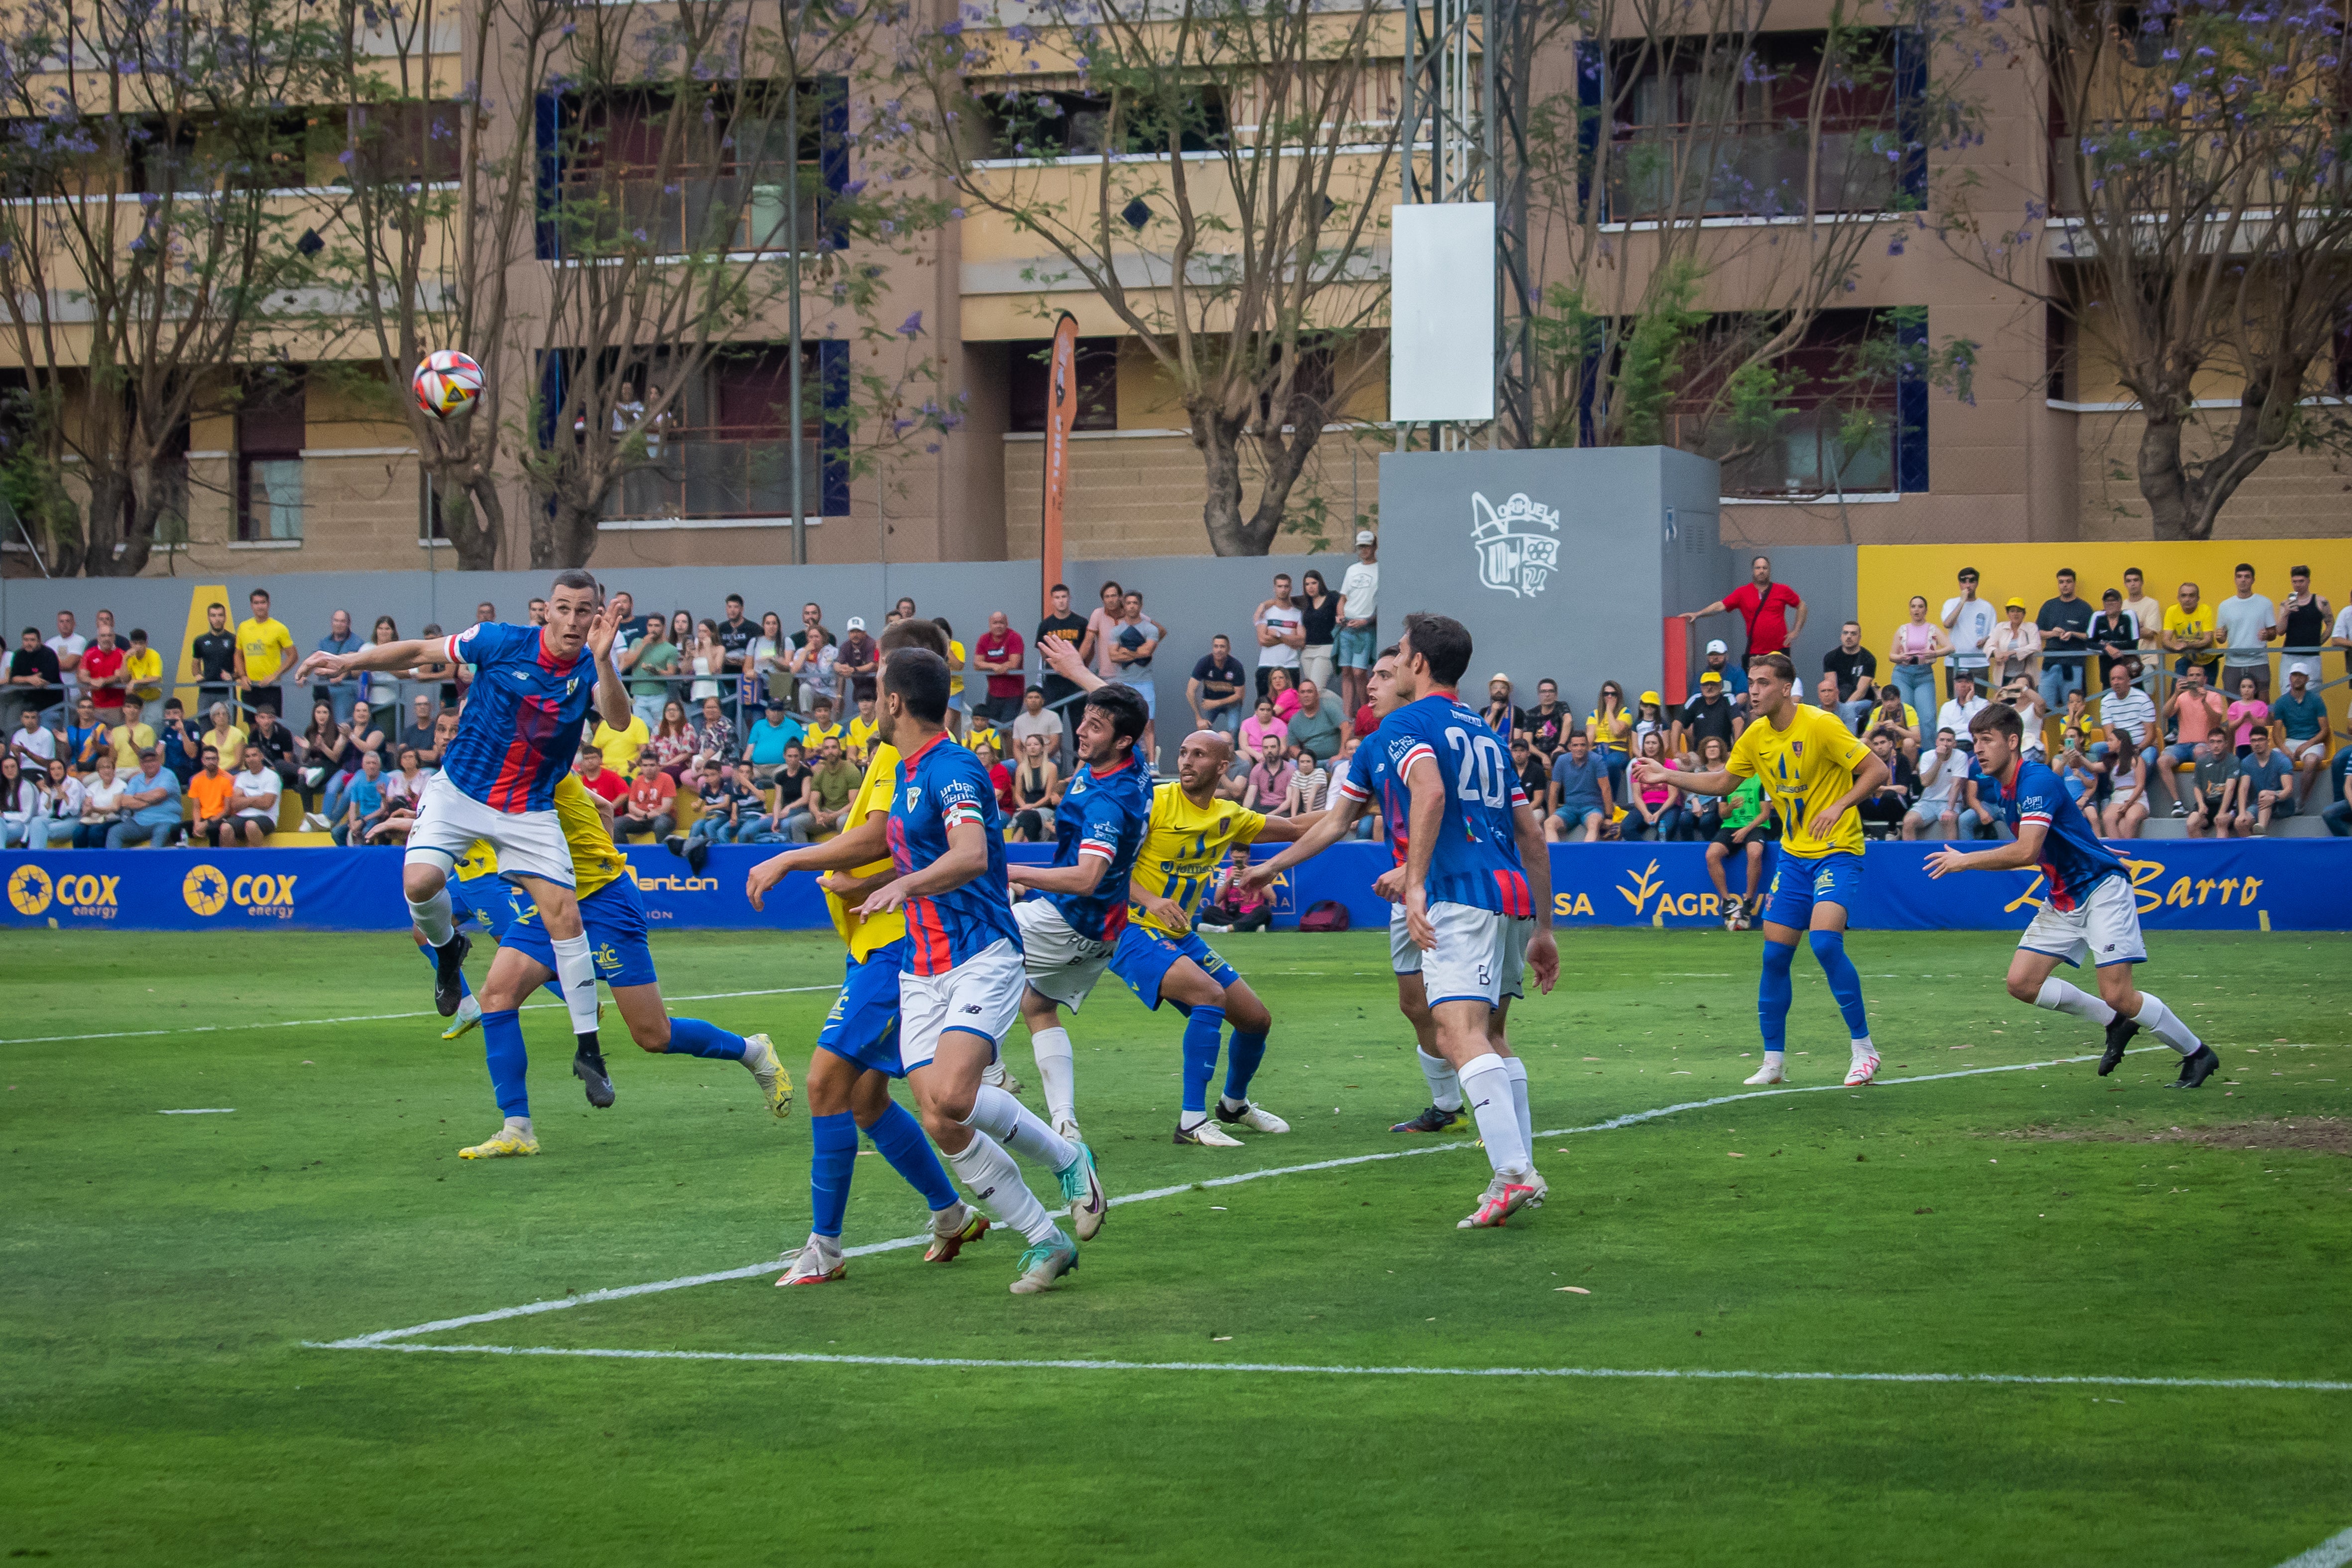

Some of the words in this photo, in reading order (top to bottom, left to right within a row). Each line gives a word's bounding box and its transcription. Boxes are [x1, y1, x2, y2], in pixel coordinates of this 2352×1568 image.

[1445, 726, 1505, 809] 20
[56, 874, 120, 906] COX
[232, 874, 298, 906] COX
[72, 906, 118, 919] energy
[247, 906, 295, 919] energy
